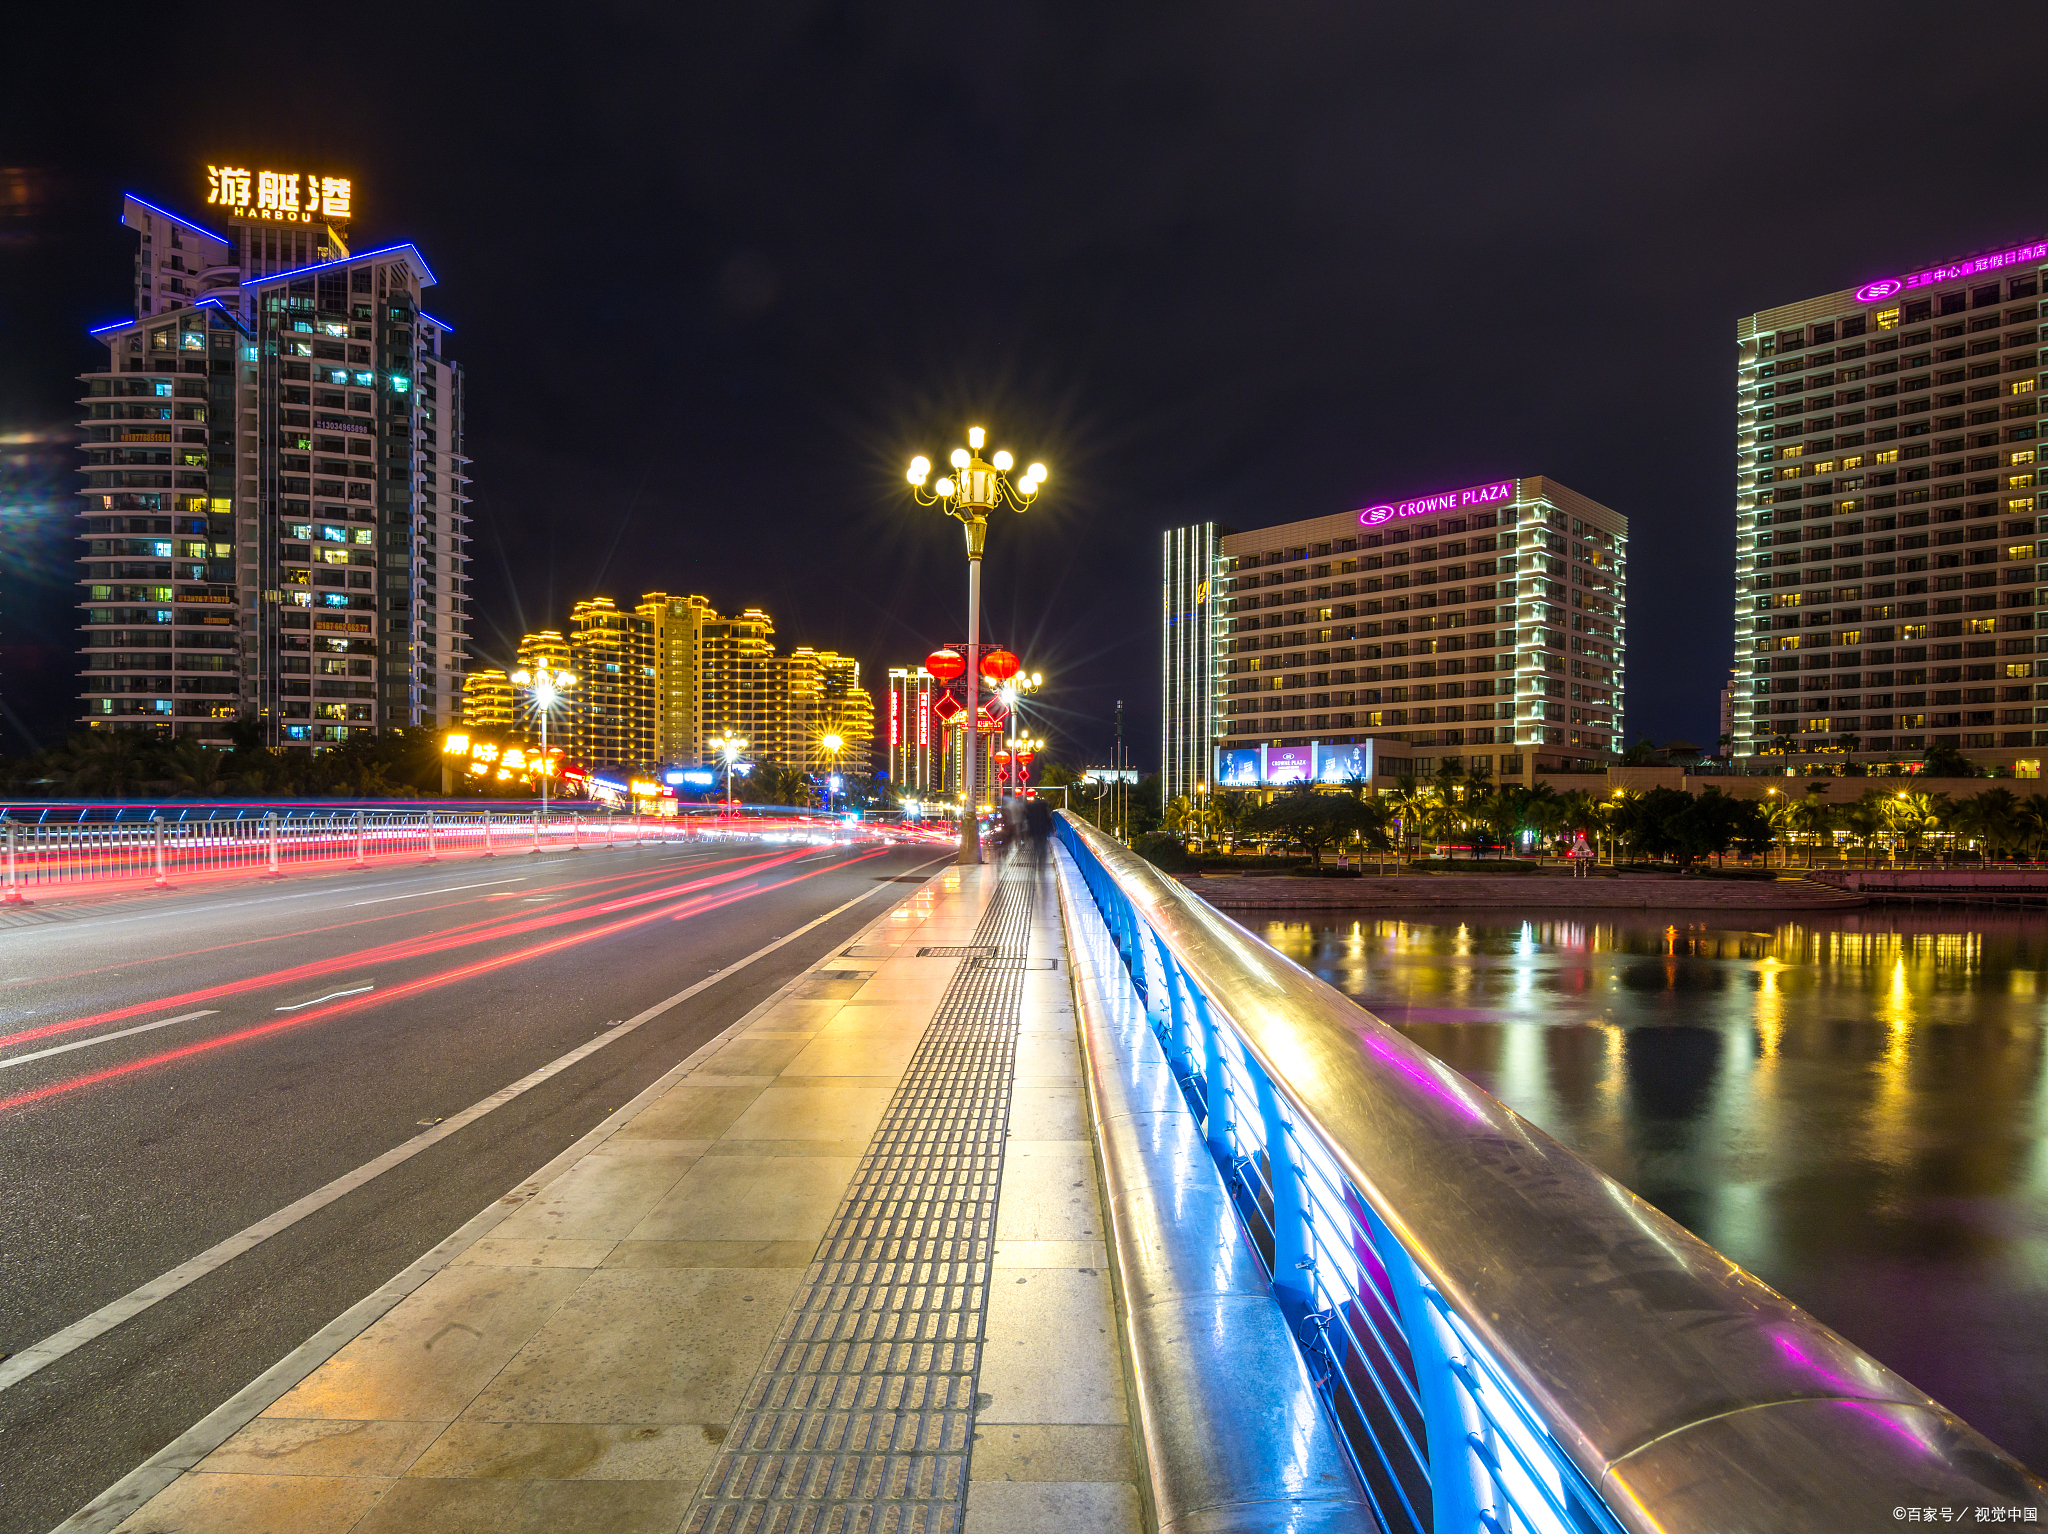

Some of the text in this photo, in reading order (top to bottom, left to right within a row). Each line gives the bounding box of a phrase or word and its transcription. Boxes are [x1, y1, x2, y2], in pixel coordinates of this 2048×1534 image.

[207, 165, 351, 218] 游艇港
[234, 206, 312, 222] HARBOU
[1905, 243, 2047, 289] 三亚中心皇冠假日酒店
[1399, 484, 1509, 517] CROWNE PLAZA
